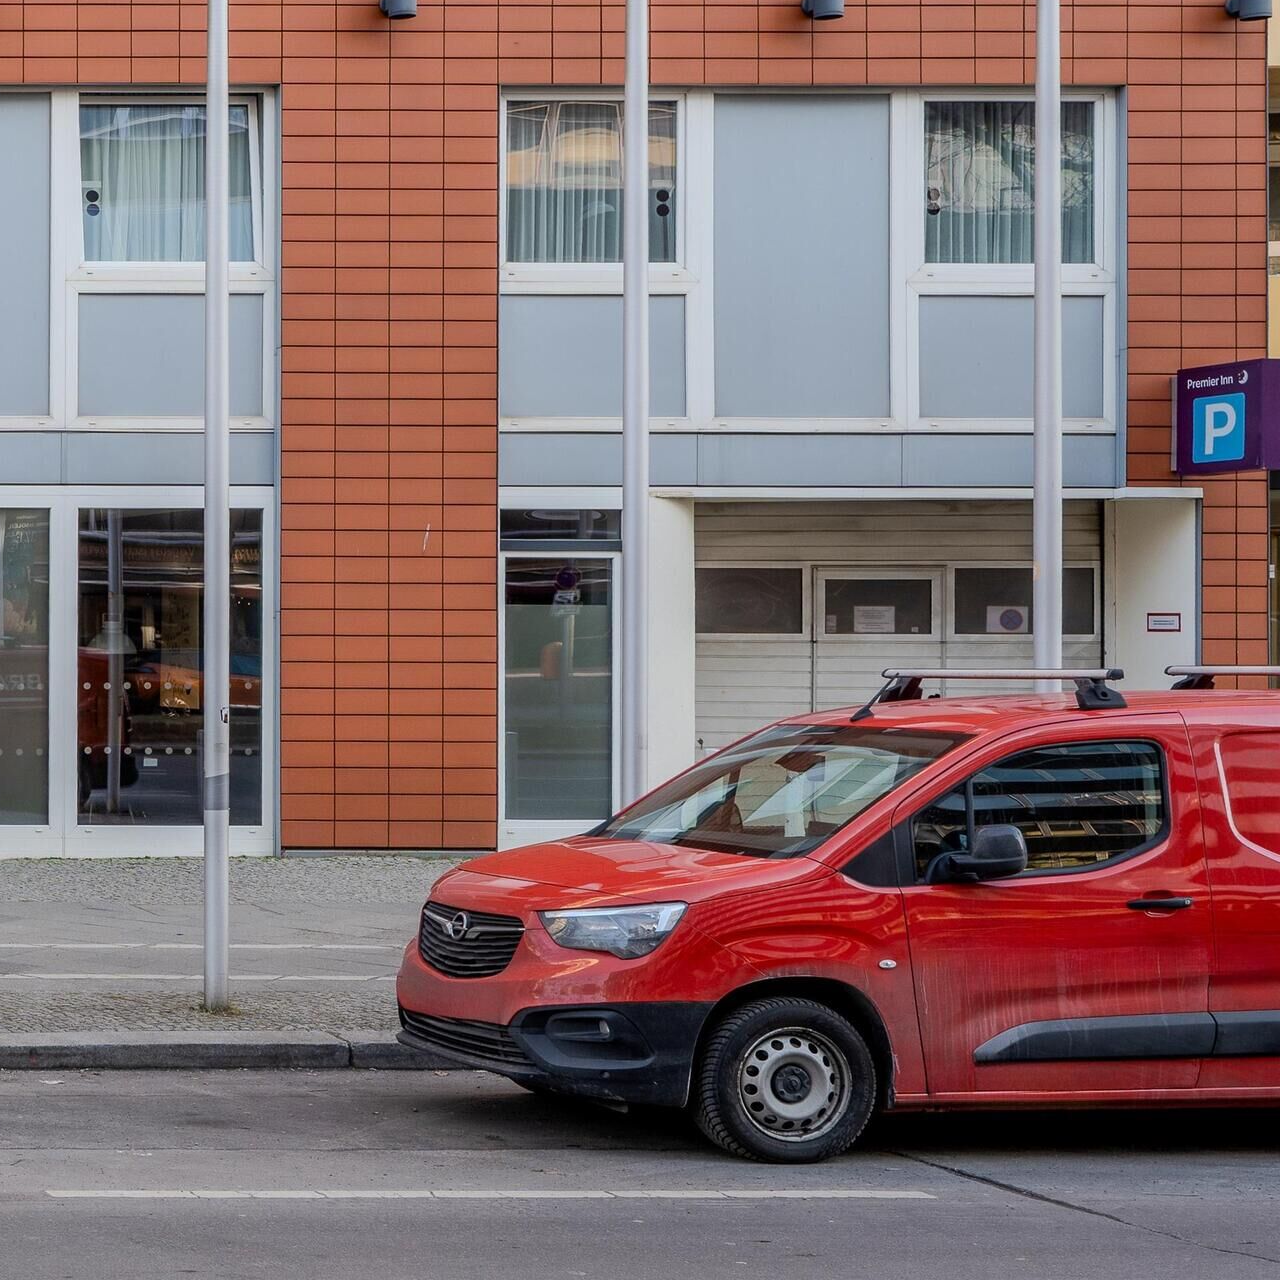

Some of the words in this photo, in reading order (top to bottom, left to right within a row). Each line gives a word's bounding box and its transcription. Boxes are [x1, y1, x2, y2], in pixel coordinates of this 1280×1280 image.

[1187, 377, 1220, 390] Premier
[1220, 375, 1234, 385] Inn
[1204, 402, 1237, 455] P
